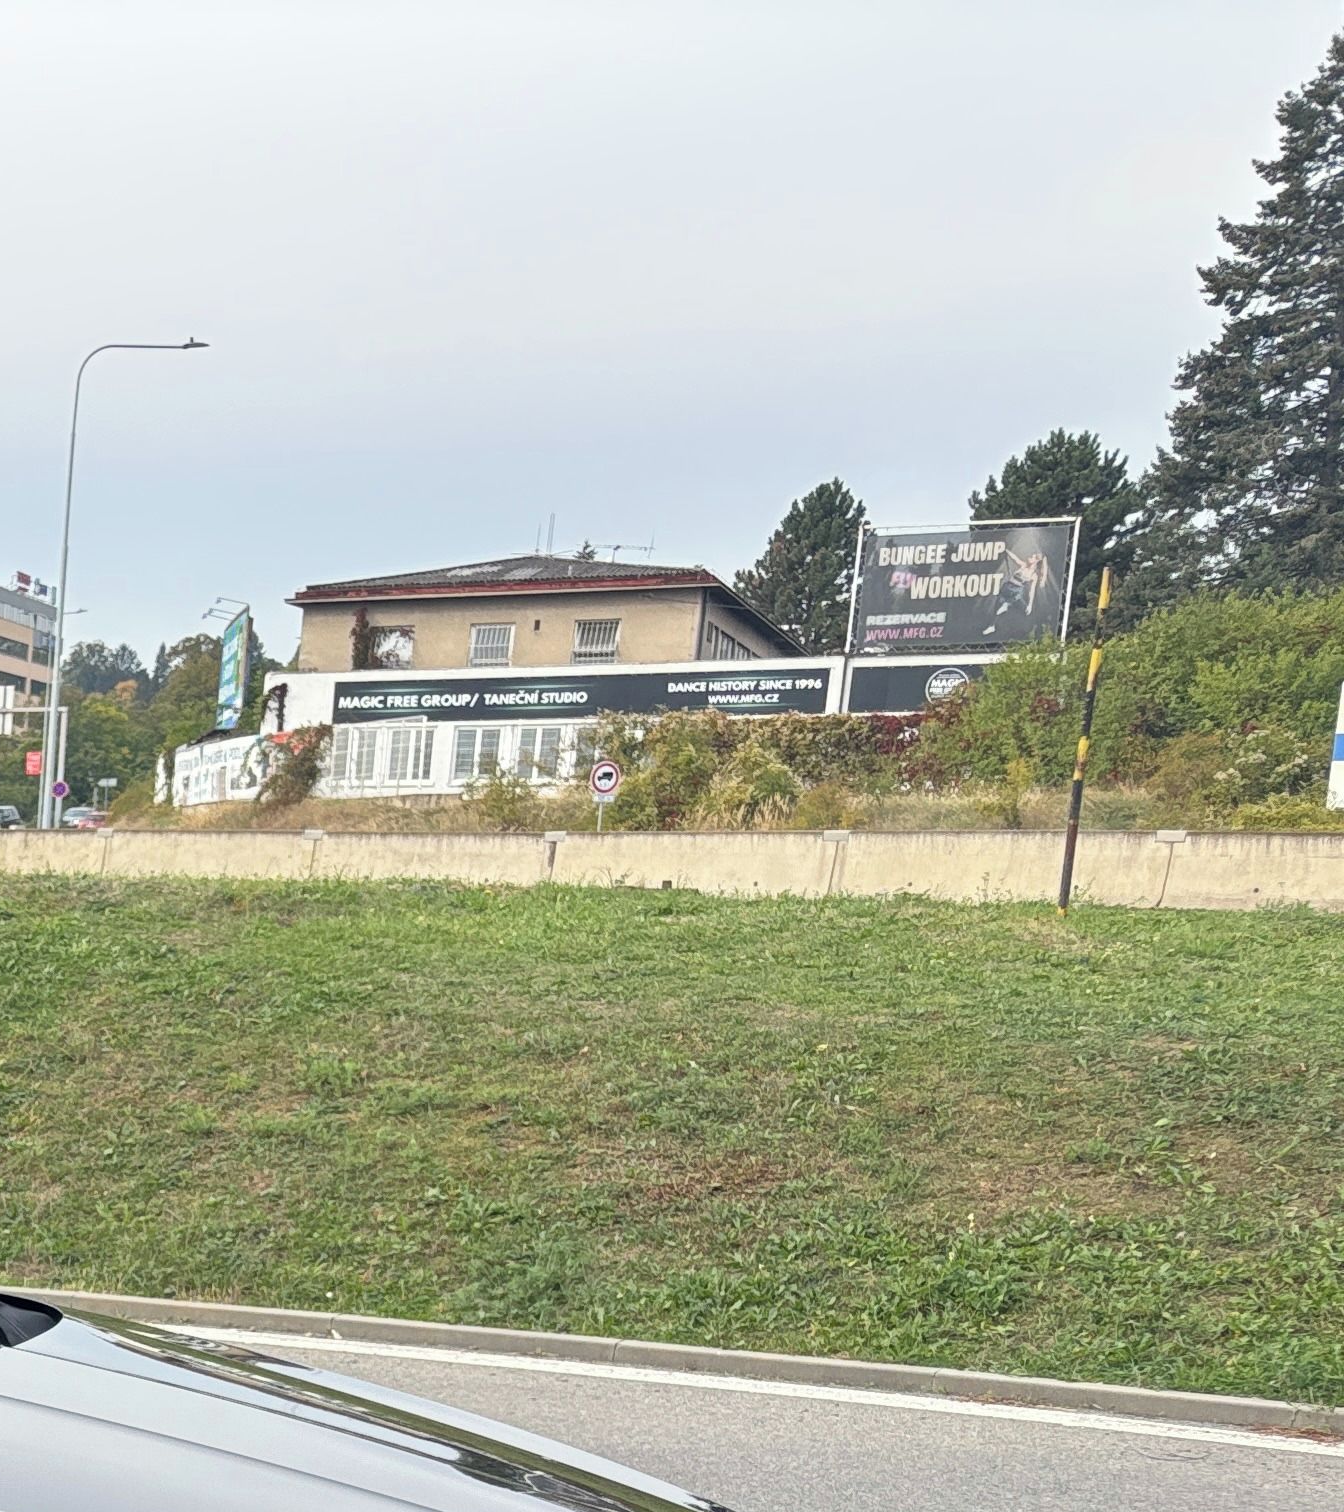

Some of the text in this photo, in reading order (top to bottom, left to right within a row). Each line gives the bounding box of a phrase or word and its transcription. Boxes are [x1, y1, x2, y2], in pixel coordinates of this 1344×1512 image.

[879, 542, 1005, 566] BUNGEE JUMP
[910, 573, 1004, 600] WORKOUT
[866, 612, 946, 625] REZERVACE
[864, 626, 944, 642] WWW.MFG.CZ
[668, 679, 822, 693] DANCE HISTORY SINCE 1996
[338, 695, 384, 709] MAGIC
[387, 695, 419, 708] FREE
[483, 689, 540, 705] TANEČNÍ
[541, 691, 588, 704] STUDIO
[708, 694, 780, 705] WWW.MFG.CZ
